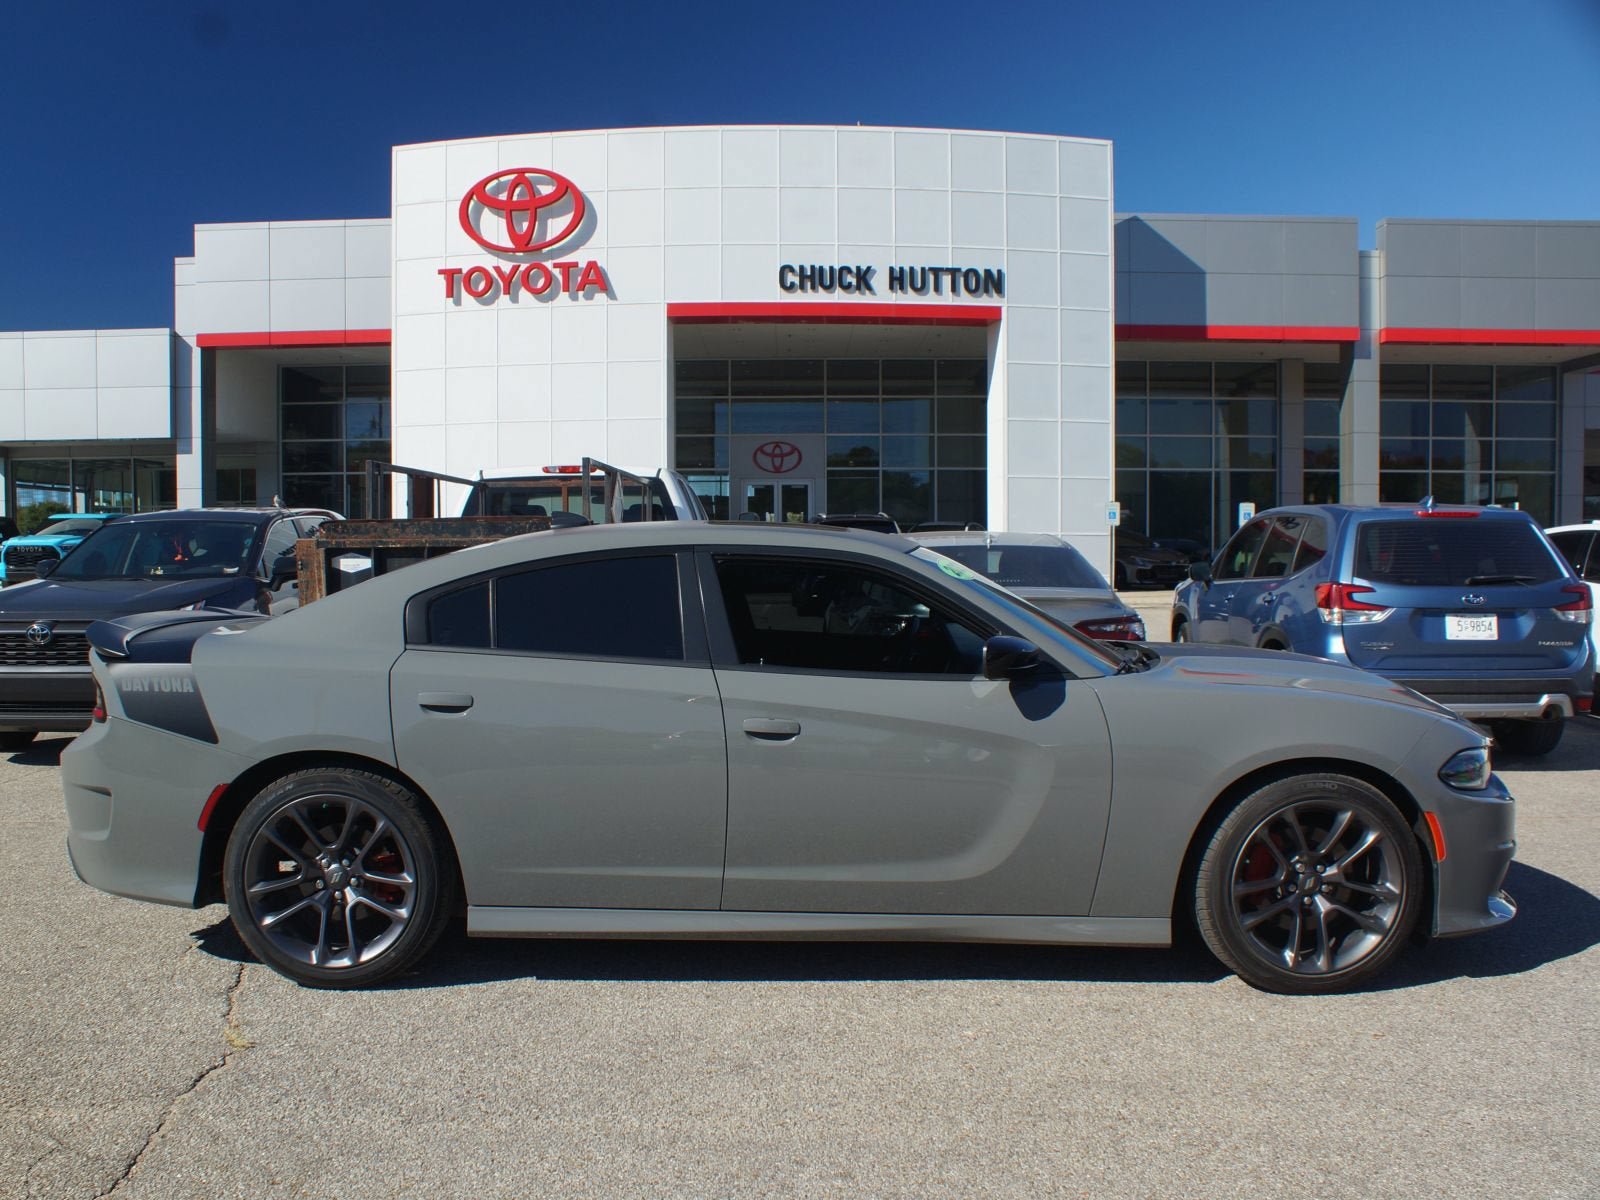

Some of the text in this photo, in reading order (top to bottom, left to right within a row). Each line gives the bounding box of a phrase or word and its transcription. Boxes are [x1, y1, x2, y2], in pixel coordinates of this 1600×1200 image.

[438, 260, 609, 299] TOYOTA
[779, 264, 1003, 295] CHUCK HUTTON
[120, 677, 195, 693] DAYTONA
